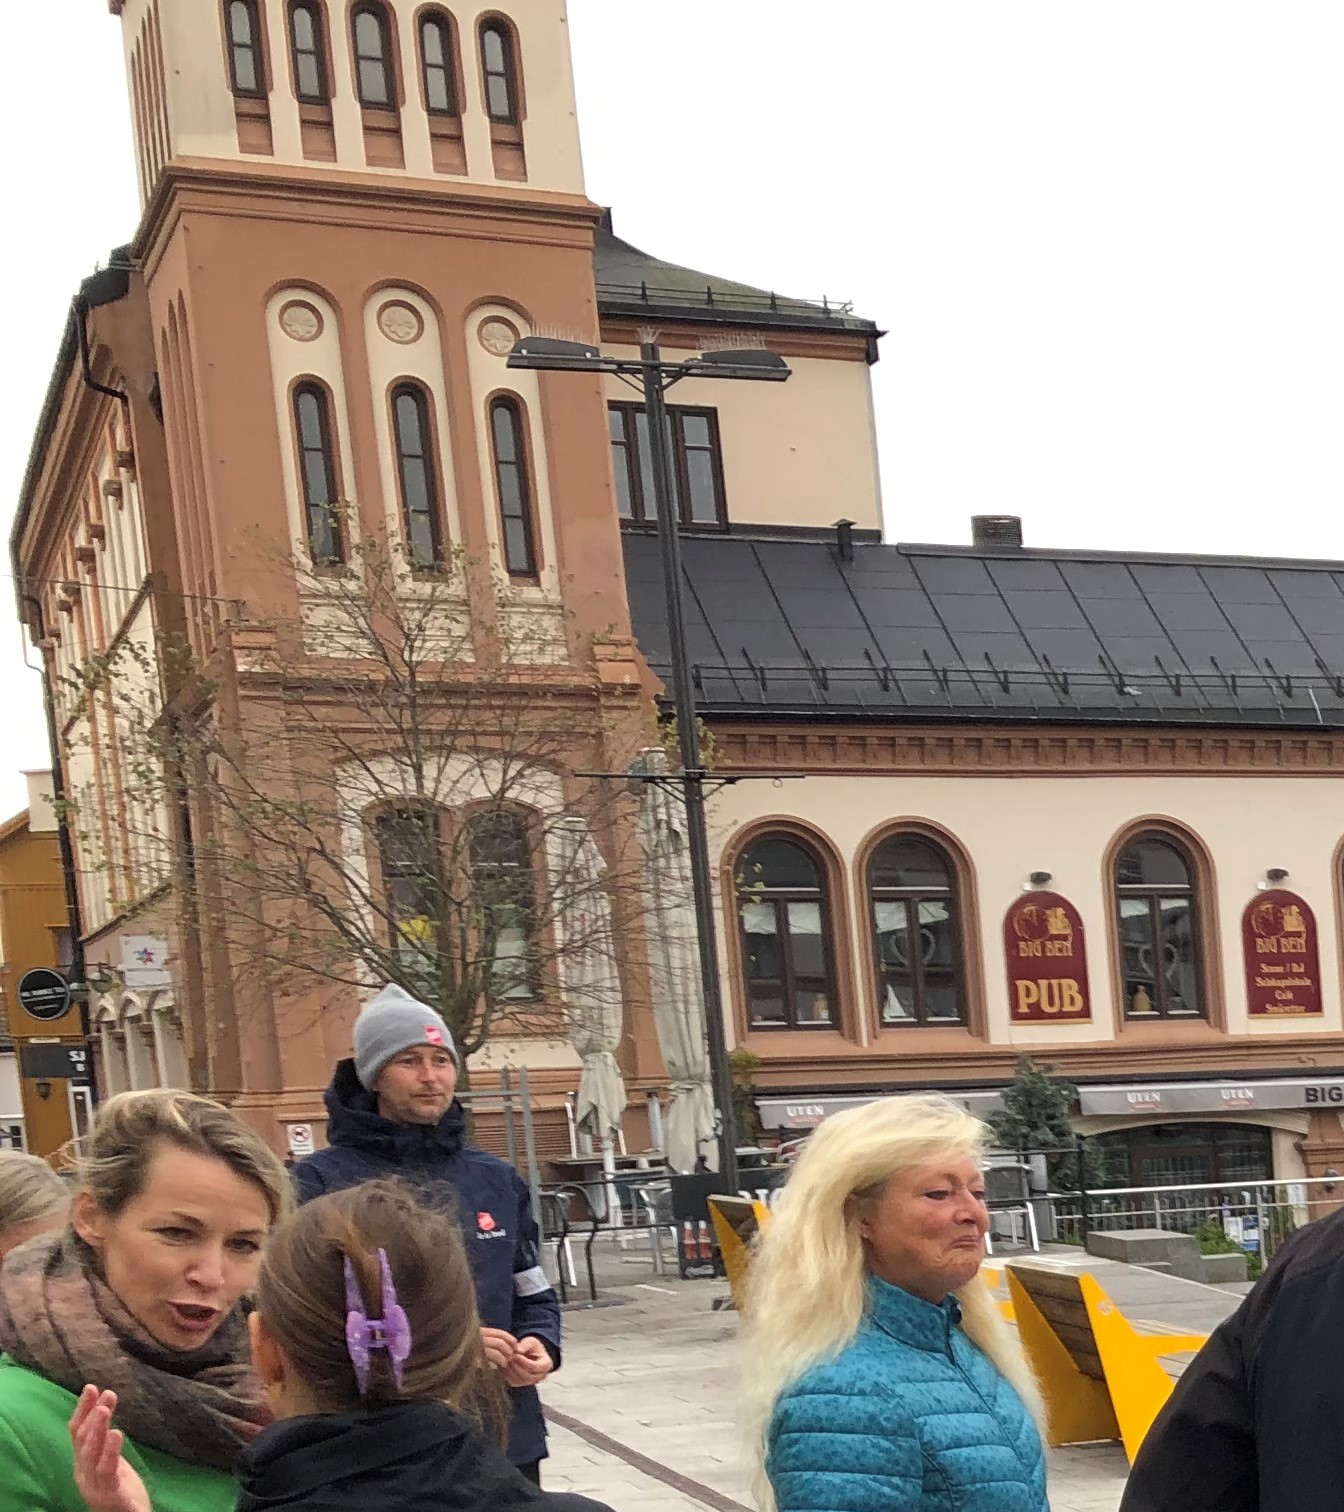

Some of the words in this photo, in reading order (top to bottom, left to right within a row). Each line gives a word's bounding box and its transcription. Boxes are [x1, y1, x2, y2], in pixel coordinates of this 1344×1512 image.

[1018, 940, 1042, 957] BIG
[1045, 940, 1073, 957] BEN
[1015, 978, 1084, 1013] PUB
[1305, 1086, 1343, 1103] BIG
